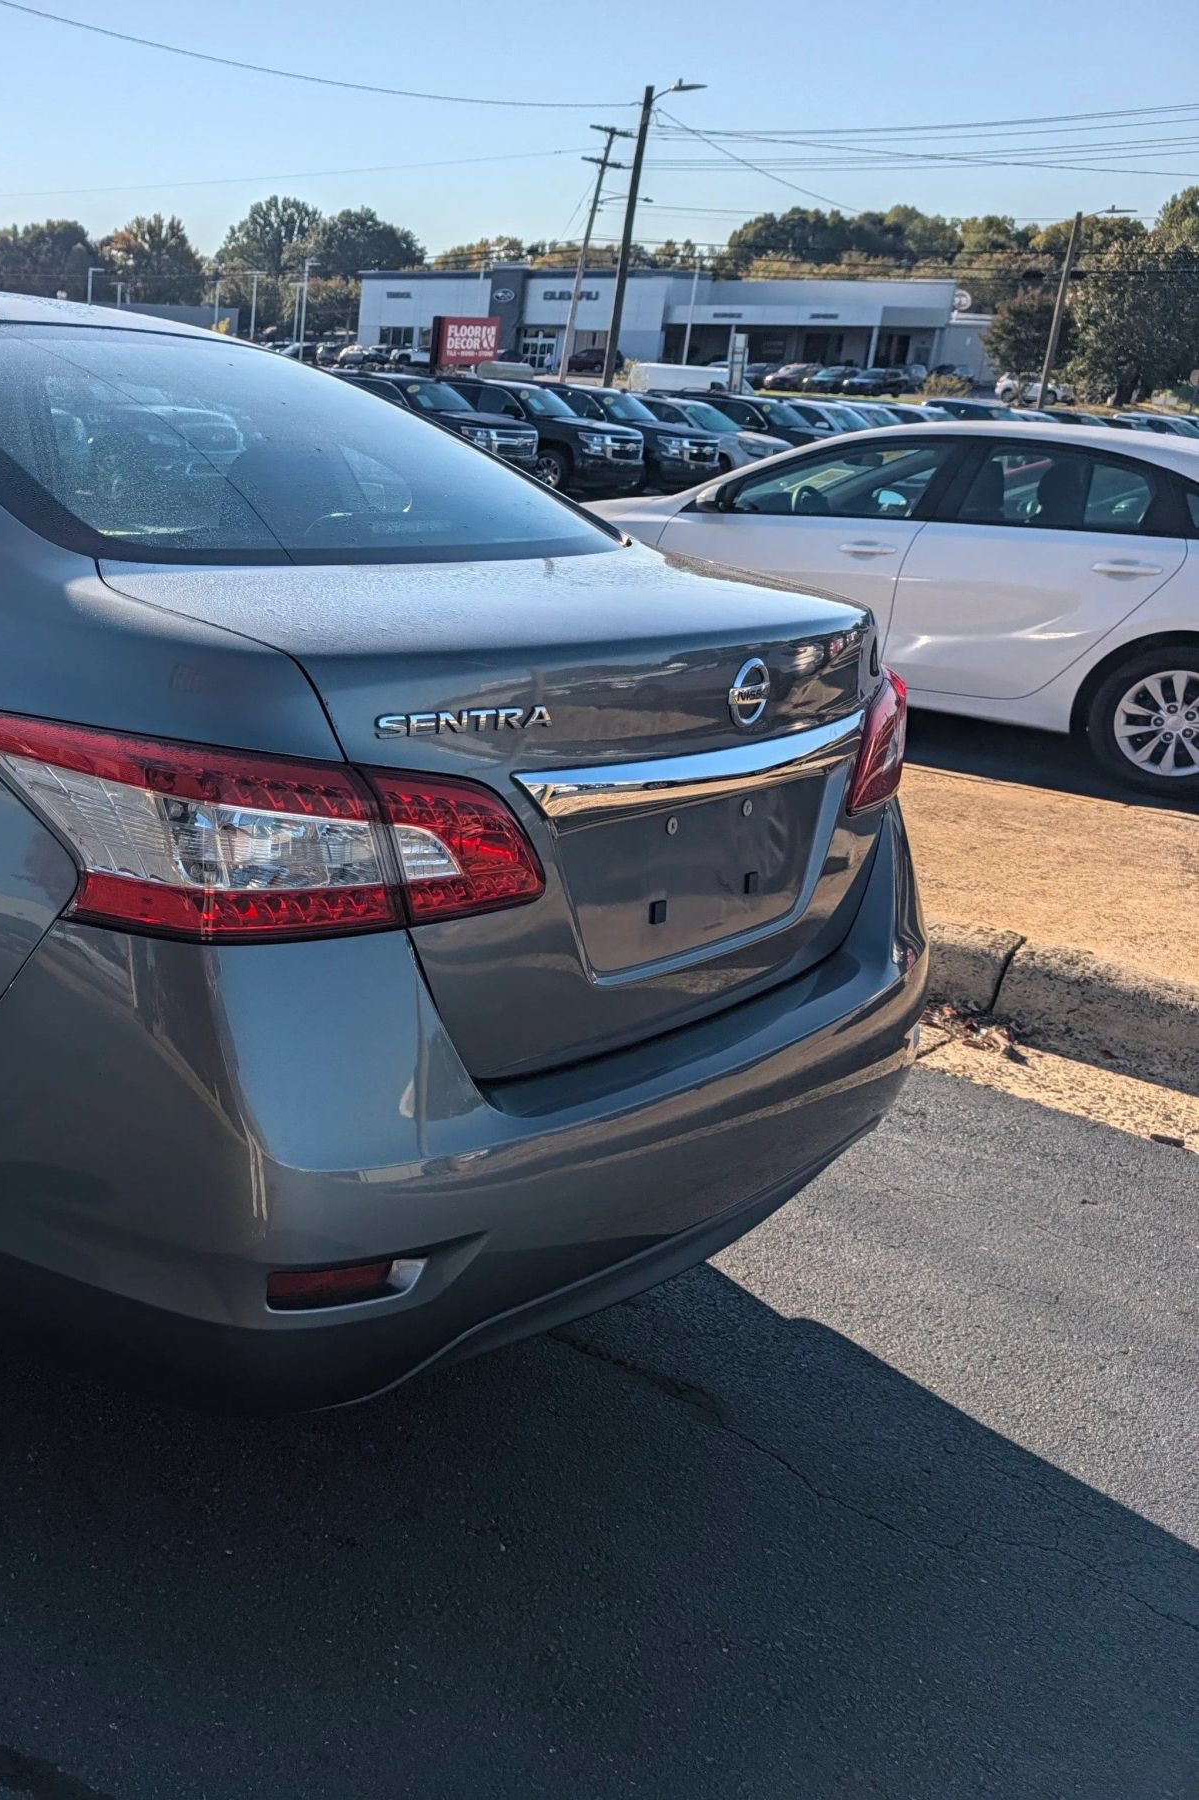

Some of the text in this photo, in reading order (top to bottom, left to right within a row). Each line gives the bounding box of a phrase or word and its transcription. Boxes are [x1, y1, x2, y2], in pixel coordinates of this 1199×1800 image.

[543, 290, 599, 301] SUBRU
[448, 324, 482, 337] FLOOR
[447, 337, 481, 350] DECOR
[375, 704, 552, 740] SENTRA
